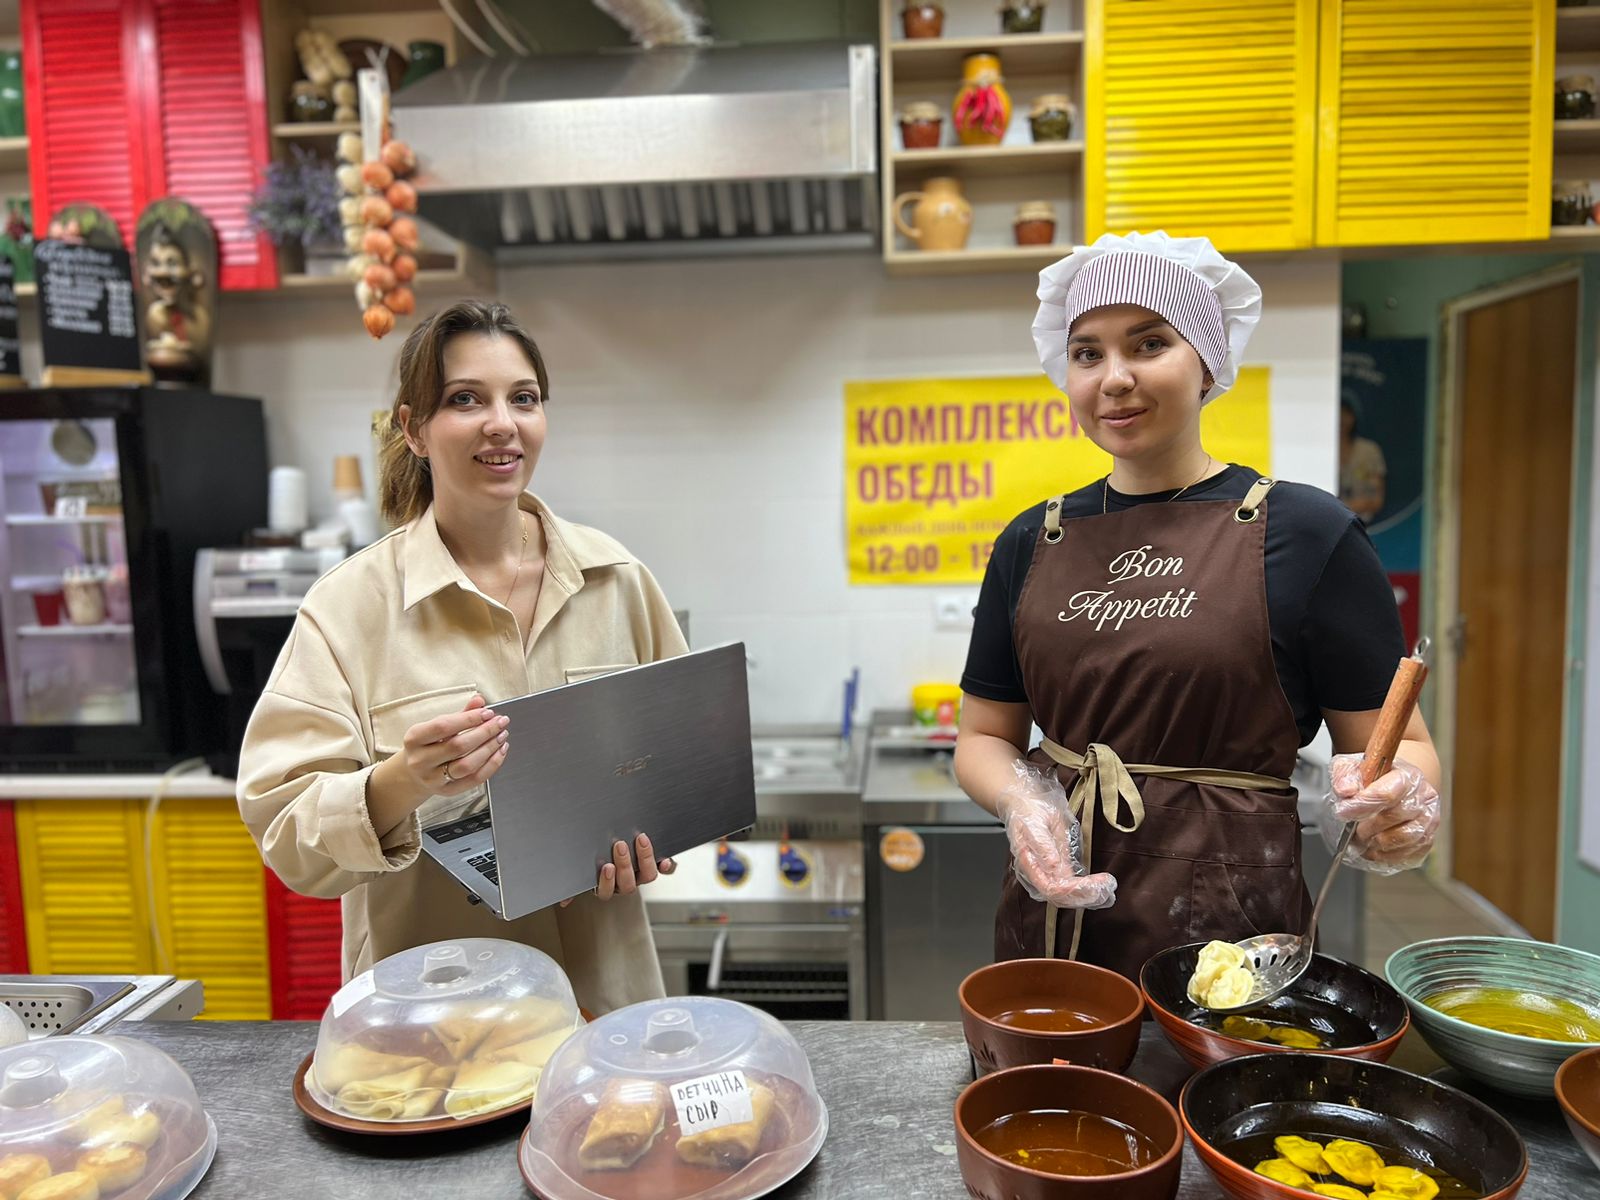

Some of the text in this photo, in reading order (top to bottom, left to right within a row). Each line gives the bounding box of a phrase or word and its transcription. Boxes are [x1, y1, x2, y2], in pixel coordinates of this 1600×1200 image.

[858, 461, 993, 509] ОБЕДЫ
[866, 544, 941, 574] 12:00
[1107, 545, 1184, 585] Bon
[1057, 587, 1198, 632] Appetit
[686, 1100, 719, 1125] СЫР
